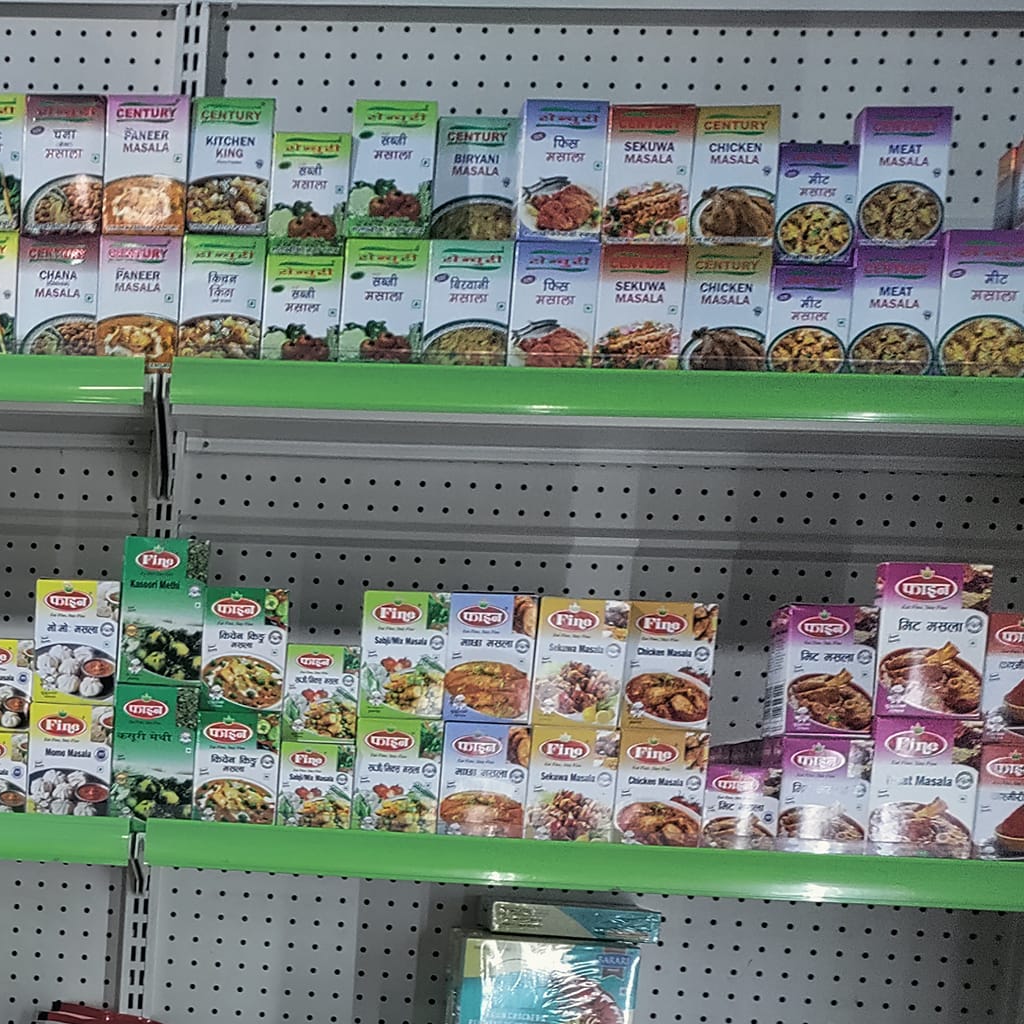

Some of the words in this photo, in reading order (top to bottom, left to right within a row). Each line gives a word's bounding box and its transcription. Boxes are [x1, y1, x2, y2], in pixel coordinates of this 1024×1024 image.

[116, 108, 177, 120] CENTURY
[703, 120, 768, 132] CENTURY
[124, 130, 169, 142] PANEER
[206, 136, 256, 147] KITCHEN
[446, 131, 509, 143] CENTURY
[122, 142, 170, 154] MASALA
[624, 142, 675, 152] SEKUWA
[708, 142, 762, 154] CHICKEN
[888, 144, 922, 154] MEAT
[216, 148, 244, 158] KING
[624, 153, 674, 164] MASALA
[453, 154, 500, 165] BIRYANI
[710, 154, 760, 166] MASALA
[879, 156, 929, 167] MASALA
[452, 166, 500, 177] MASALA
[695, 260, 759, 271] CENTURY
[38, 270, 78, 280] CHANA
[116, 269, 161, 280] PANEER
[114, 282, 161, 293] MASALA
[614, 281, 666, 292] SEKUWA
[700, 282, 753, 294] CHICKEN
[879, 286, 913, 297] MEAT
[34, 288, 81, 298] MASALA
[614, 292, 664, 304] MASALA
[700, 294, 750, 306] MASALA
[868, 299, 920, 309] MASALA
[902, 582, 950, 598] फाइन
[44, 748, 65, 758] Momo
[68, 749, 92, 758] Masala
